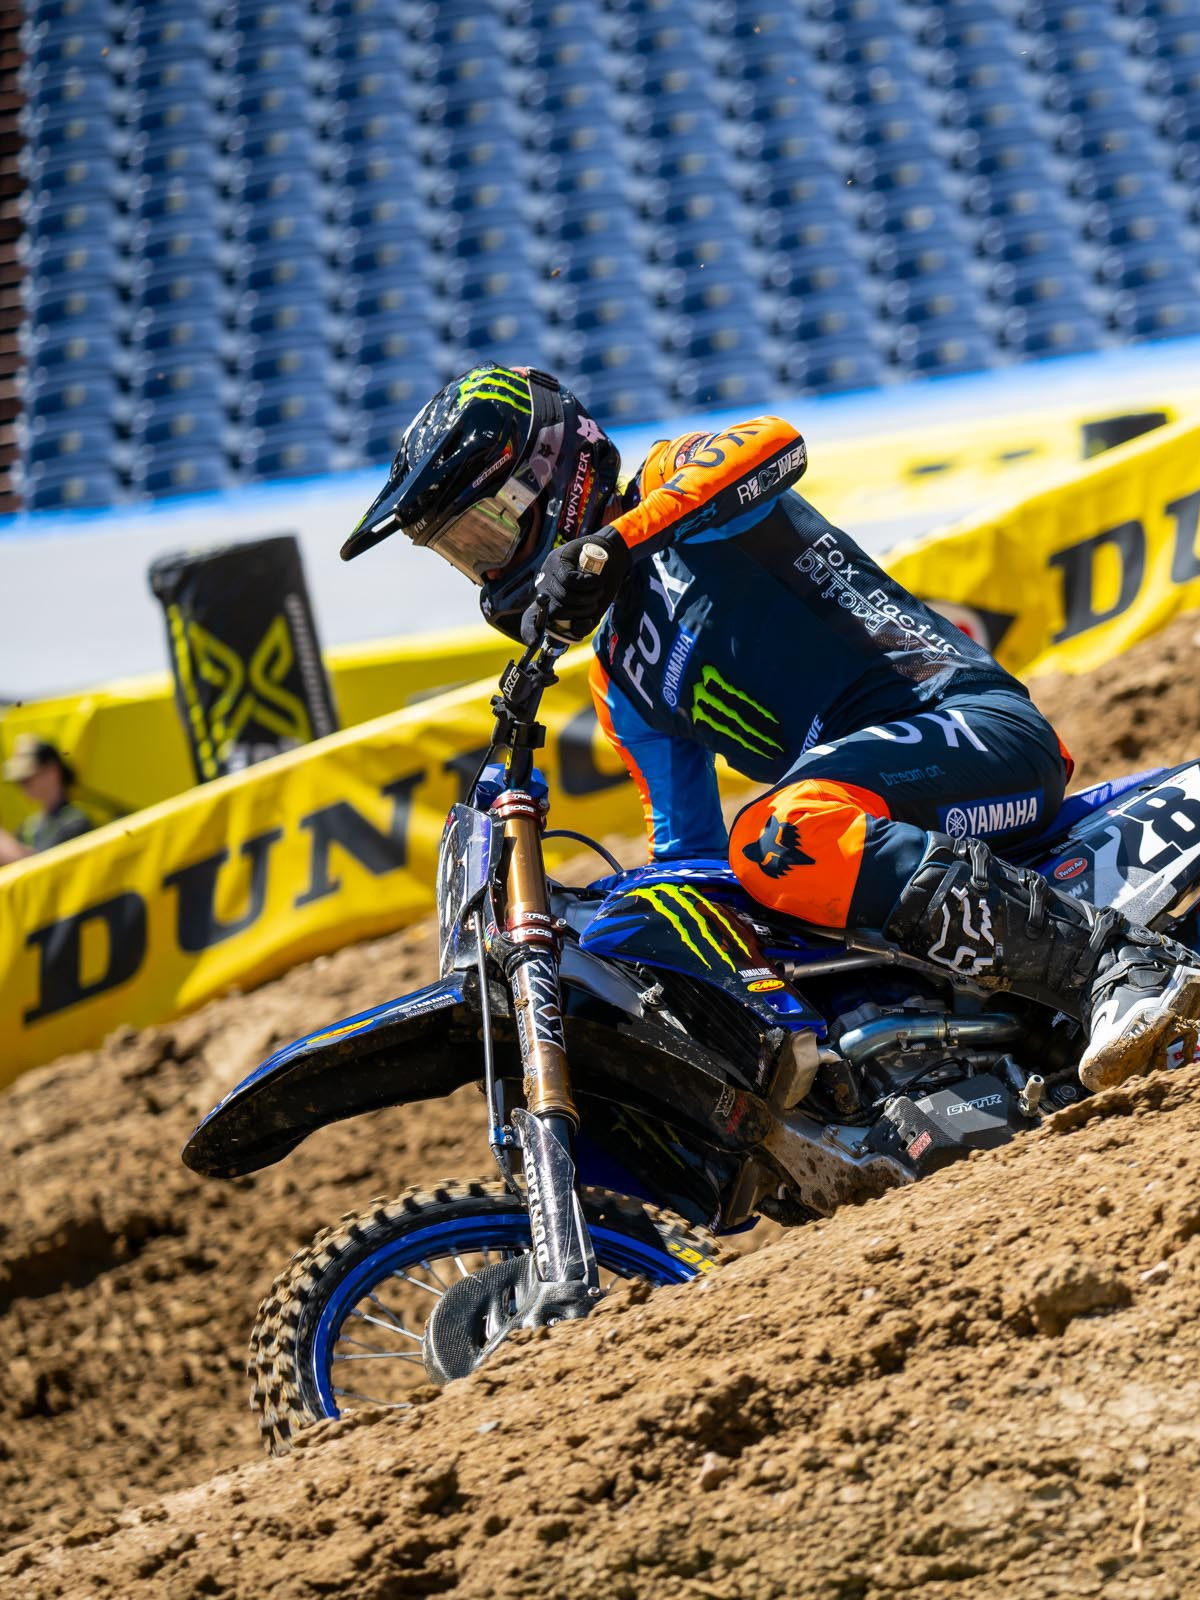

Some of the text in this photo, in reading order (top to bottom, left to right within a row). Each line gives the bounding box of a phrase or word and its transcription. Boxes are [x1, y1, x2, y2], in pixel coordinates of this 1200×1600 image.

[564, 451, 591, 533] MONSTER
[812, 532, 860, 582] Fox
[622, 551, 696, 710] FOX
[664, 633, 694, 691] YAMAHA
[503, 666, 520, 701] ARC
[880, 767, 924, 787] Dream
[966, 797, 1038, 835] YAMAHA
[1058, 859, 1084, 878] Twin Air
[409, 994, 454, 1010] YAMAHA
[947, 1094, 1003, 1116] GYTR
[522, 1146, 550, 1263] DUNLOP
